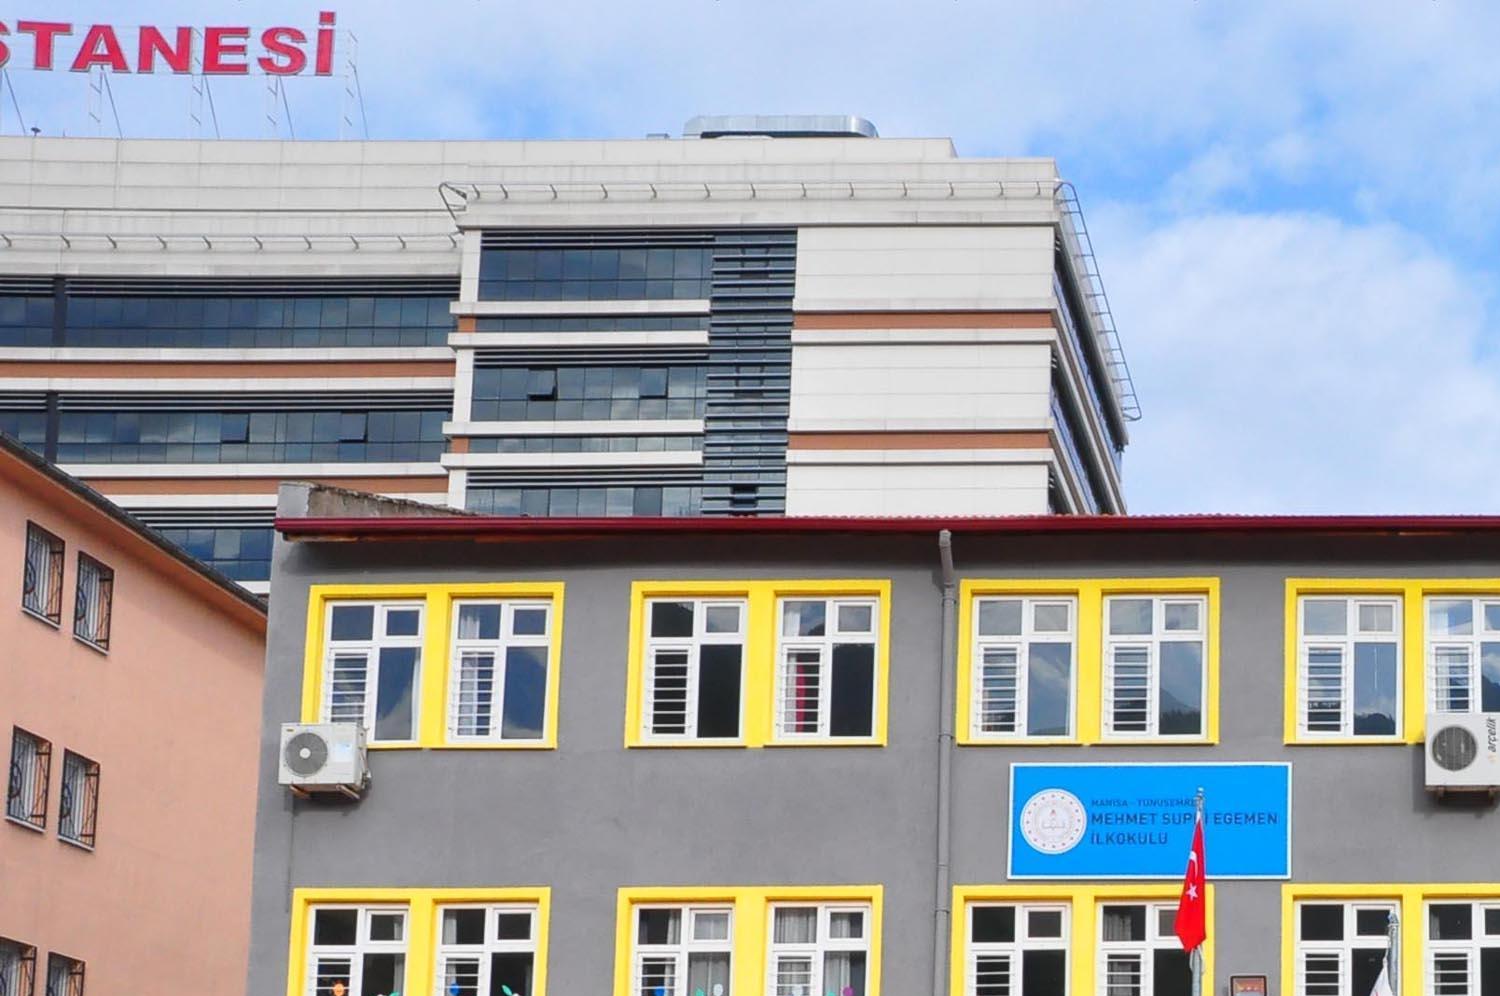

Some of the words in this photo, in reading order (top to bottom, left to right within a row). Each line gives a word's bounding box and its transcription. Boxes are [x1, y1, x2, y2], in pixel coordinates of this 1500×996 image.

[0, 11, 336, 77] TANESİ
[1091, 812, 1157, 825] MEHMET
[1214, 812, 1278, 825] EGEMEN
